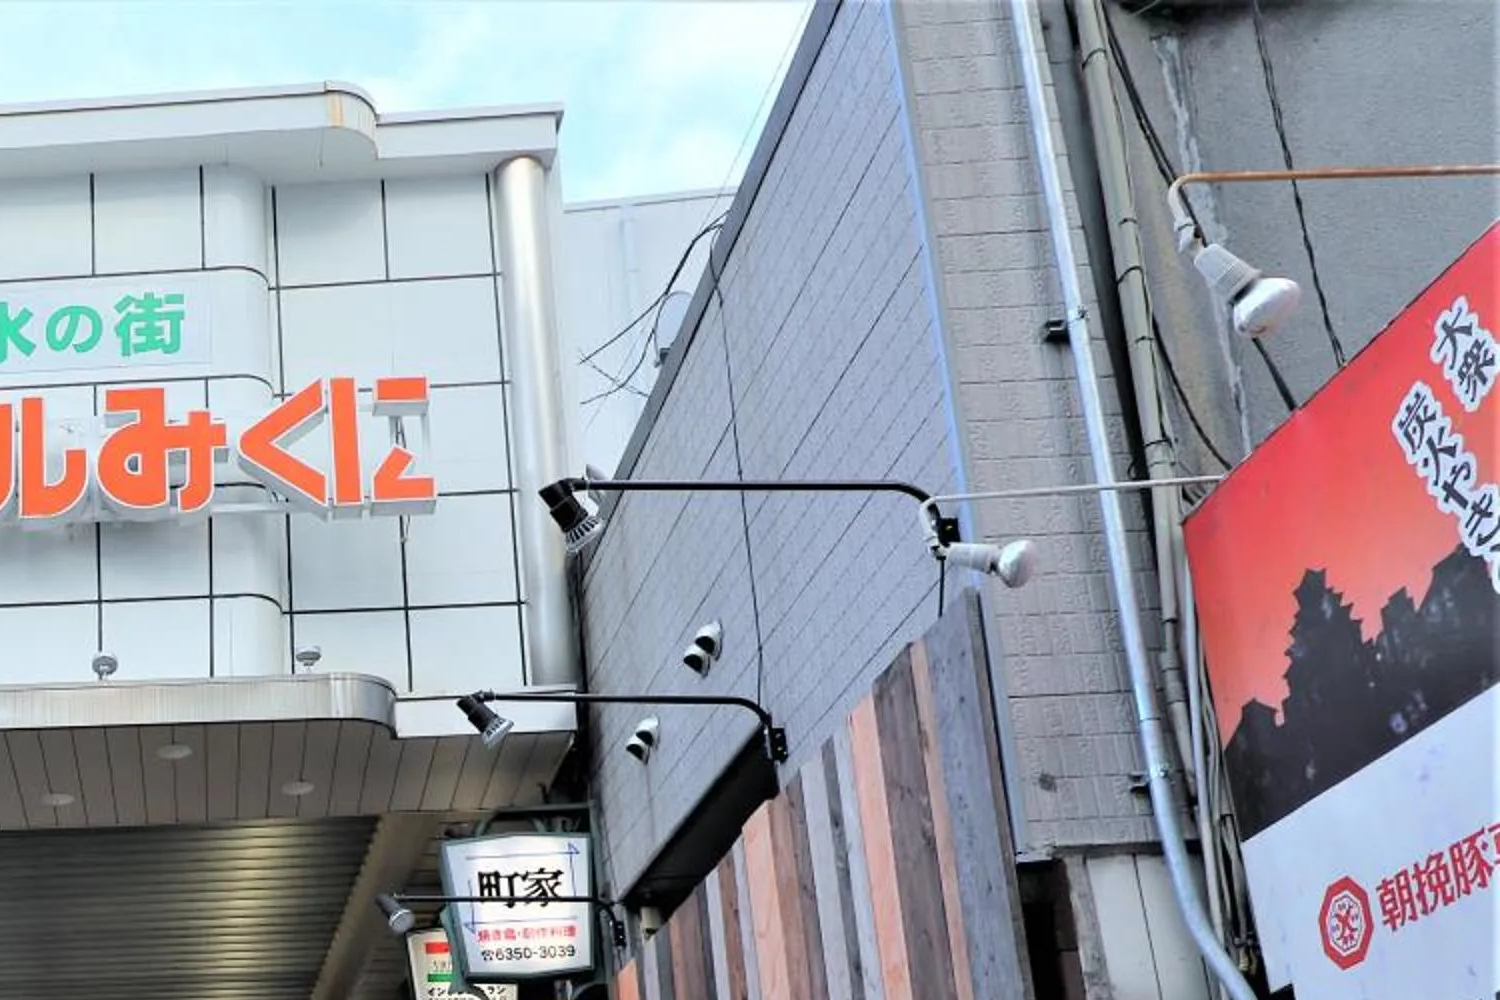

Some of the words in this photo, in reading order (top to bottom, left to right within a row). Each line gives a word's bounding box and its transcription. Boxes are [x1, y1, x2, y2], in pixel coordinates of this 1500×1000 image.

[1398, 391, 1500, 553] 炭火やき
[477, 869, 564, 910] 町家
[1375, 820, 1500, 931] 朝挽豚
[495, 945, 576, 961] 6350-3039
